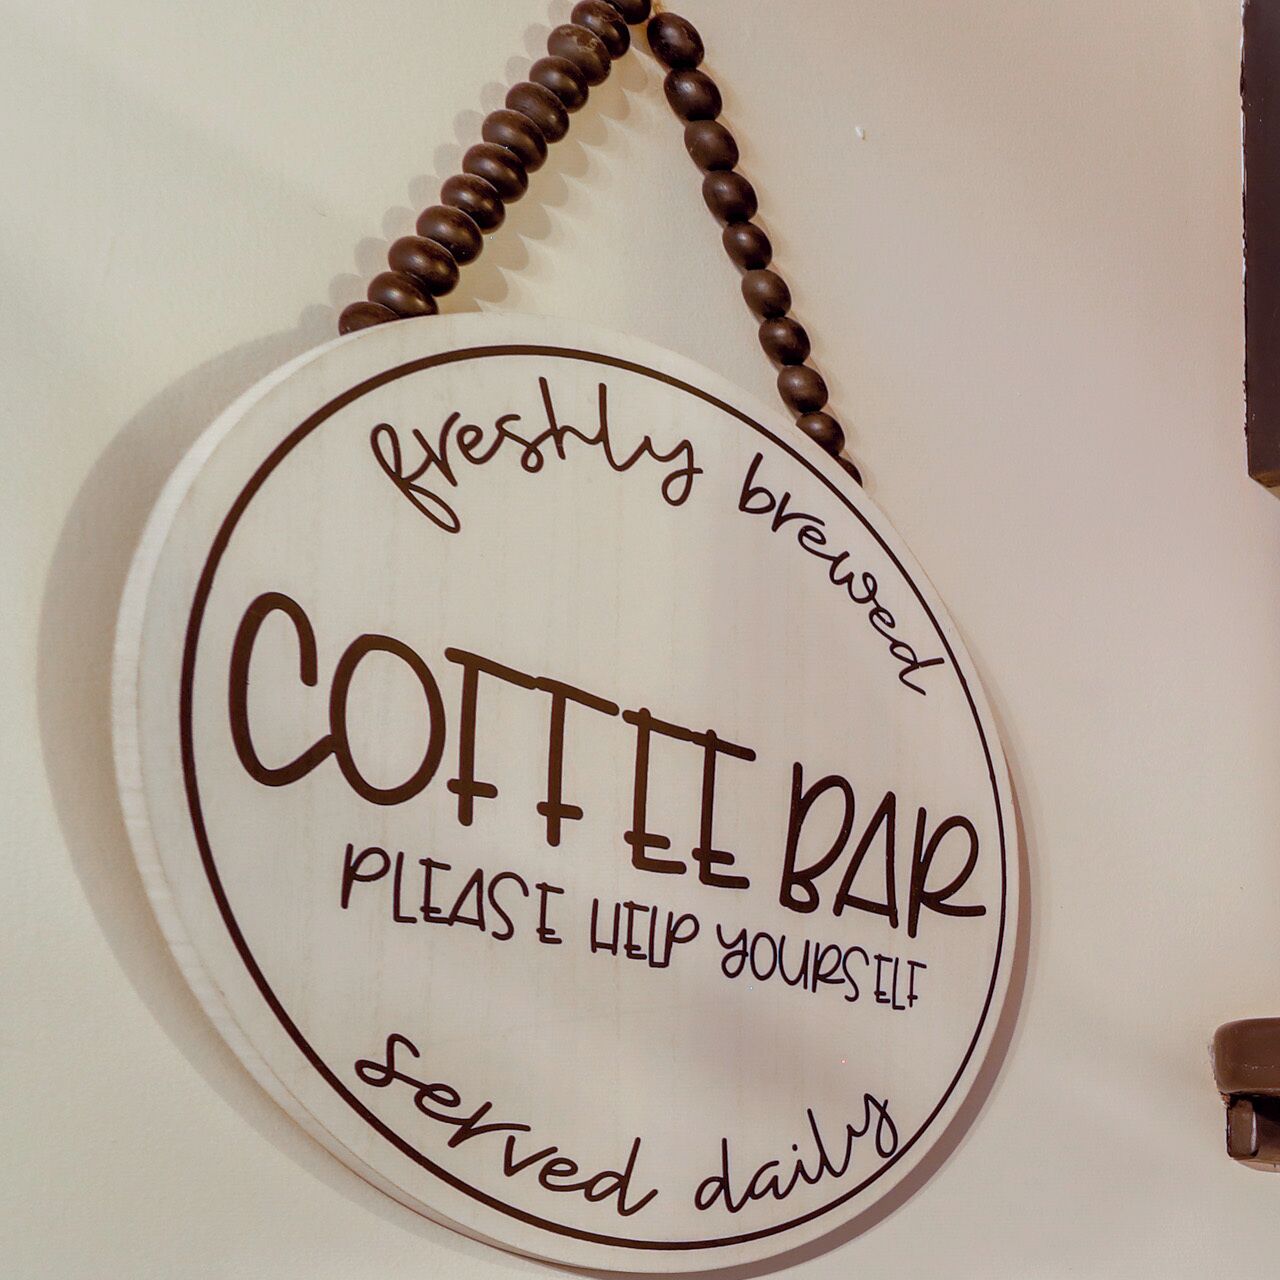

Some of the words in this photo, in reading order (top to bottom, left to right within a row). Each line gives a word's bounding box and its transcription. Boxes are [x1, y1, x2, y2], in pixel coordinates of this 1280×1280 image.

[371, 377, 703, 533] freshly
[738, 453, 945, 697] brewed
[229, 591, 756, 890] COFFEE
[779, 760, 987, 938] BAR
[341, 844, 565, 946] PLEASE
[590, 900, 699, 969] HELP
[717, 923, 928, 1011] YOURSELF
[695, 1090, 897, 1214] daily
